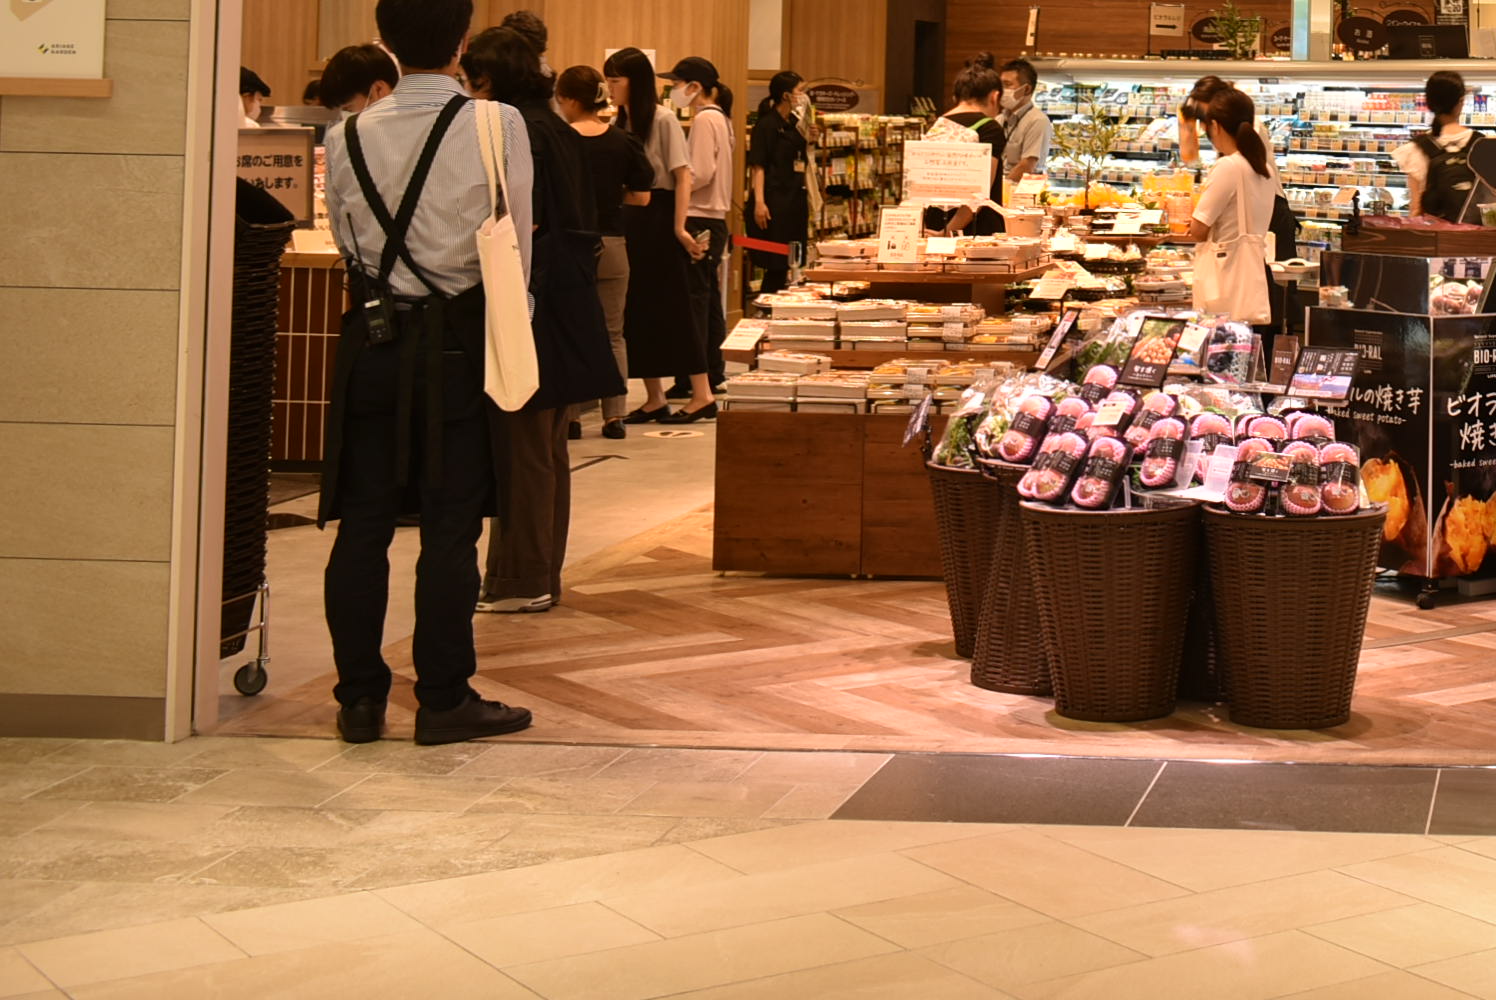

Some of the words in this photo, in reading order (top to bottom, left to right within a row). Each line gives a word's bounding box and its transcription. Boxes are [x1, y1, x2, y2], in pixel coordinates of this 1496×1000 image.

[1350, 384, 1424, 415] ルの焼き芋
